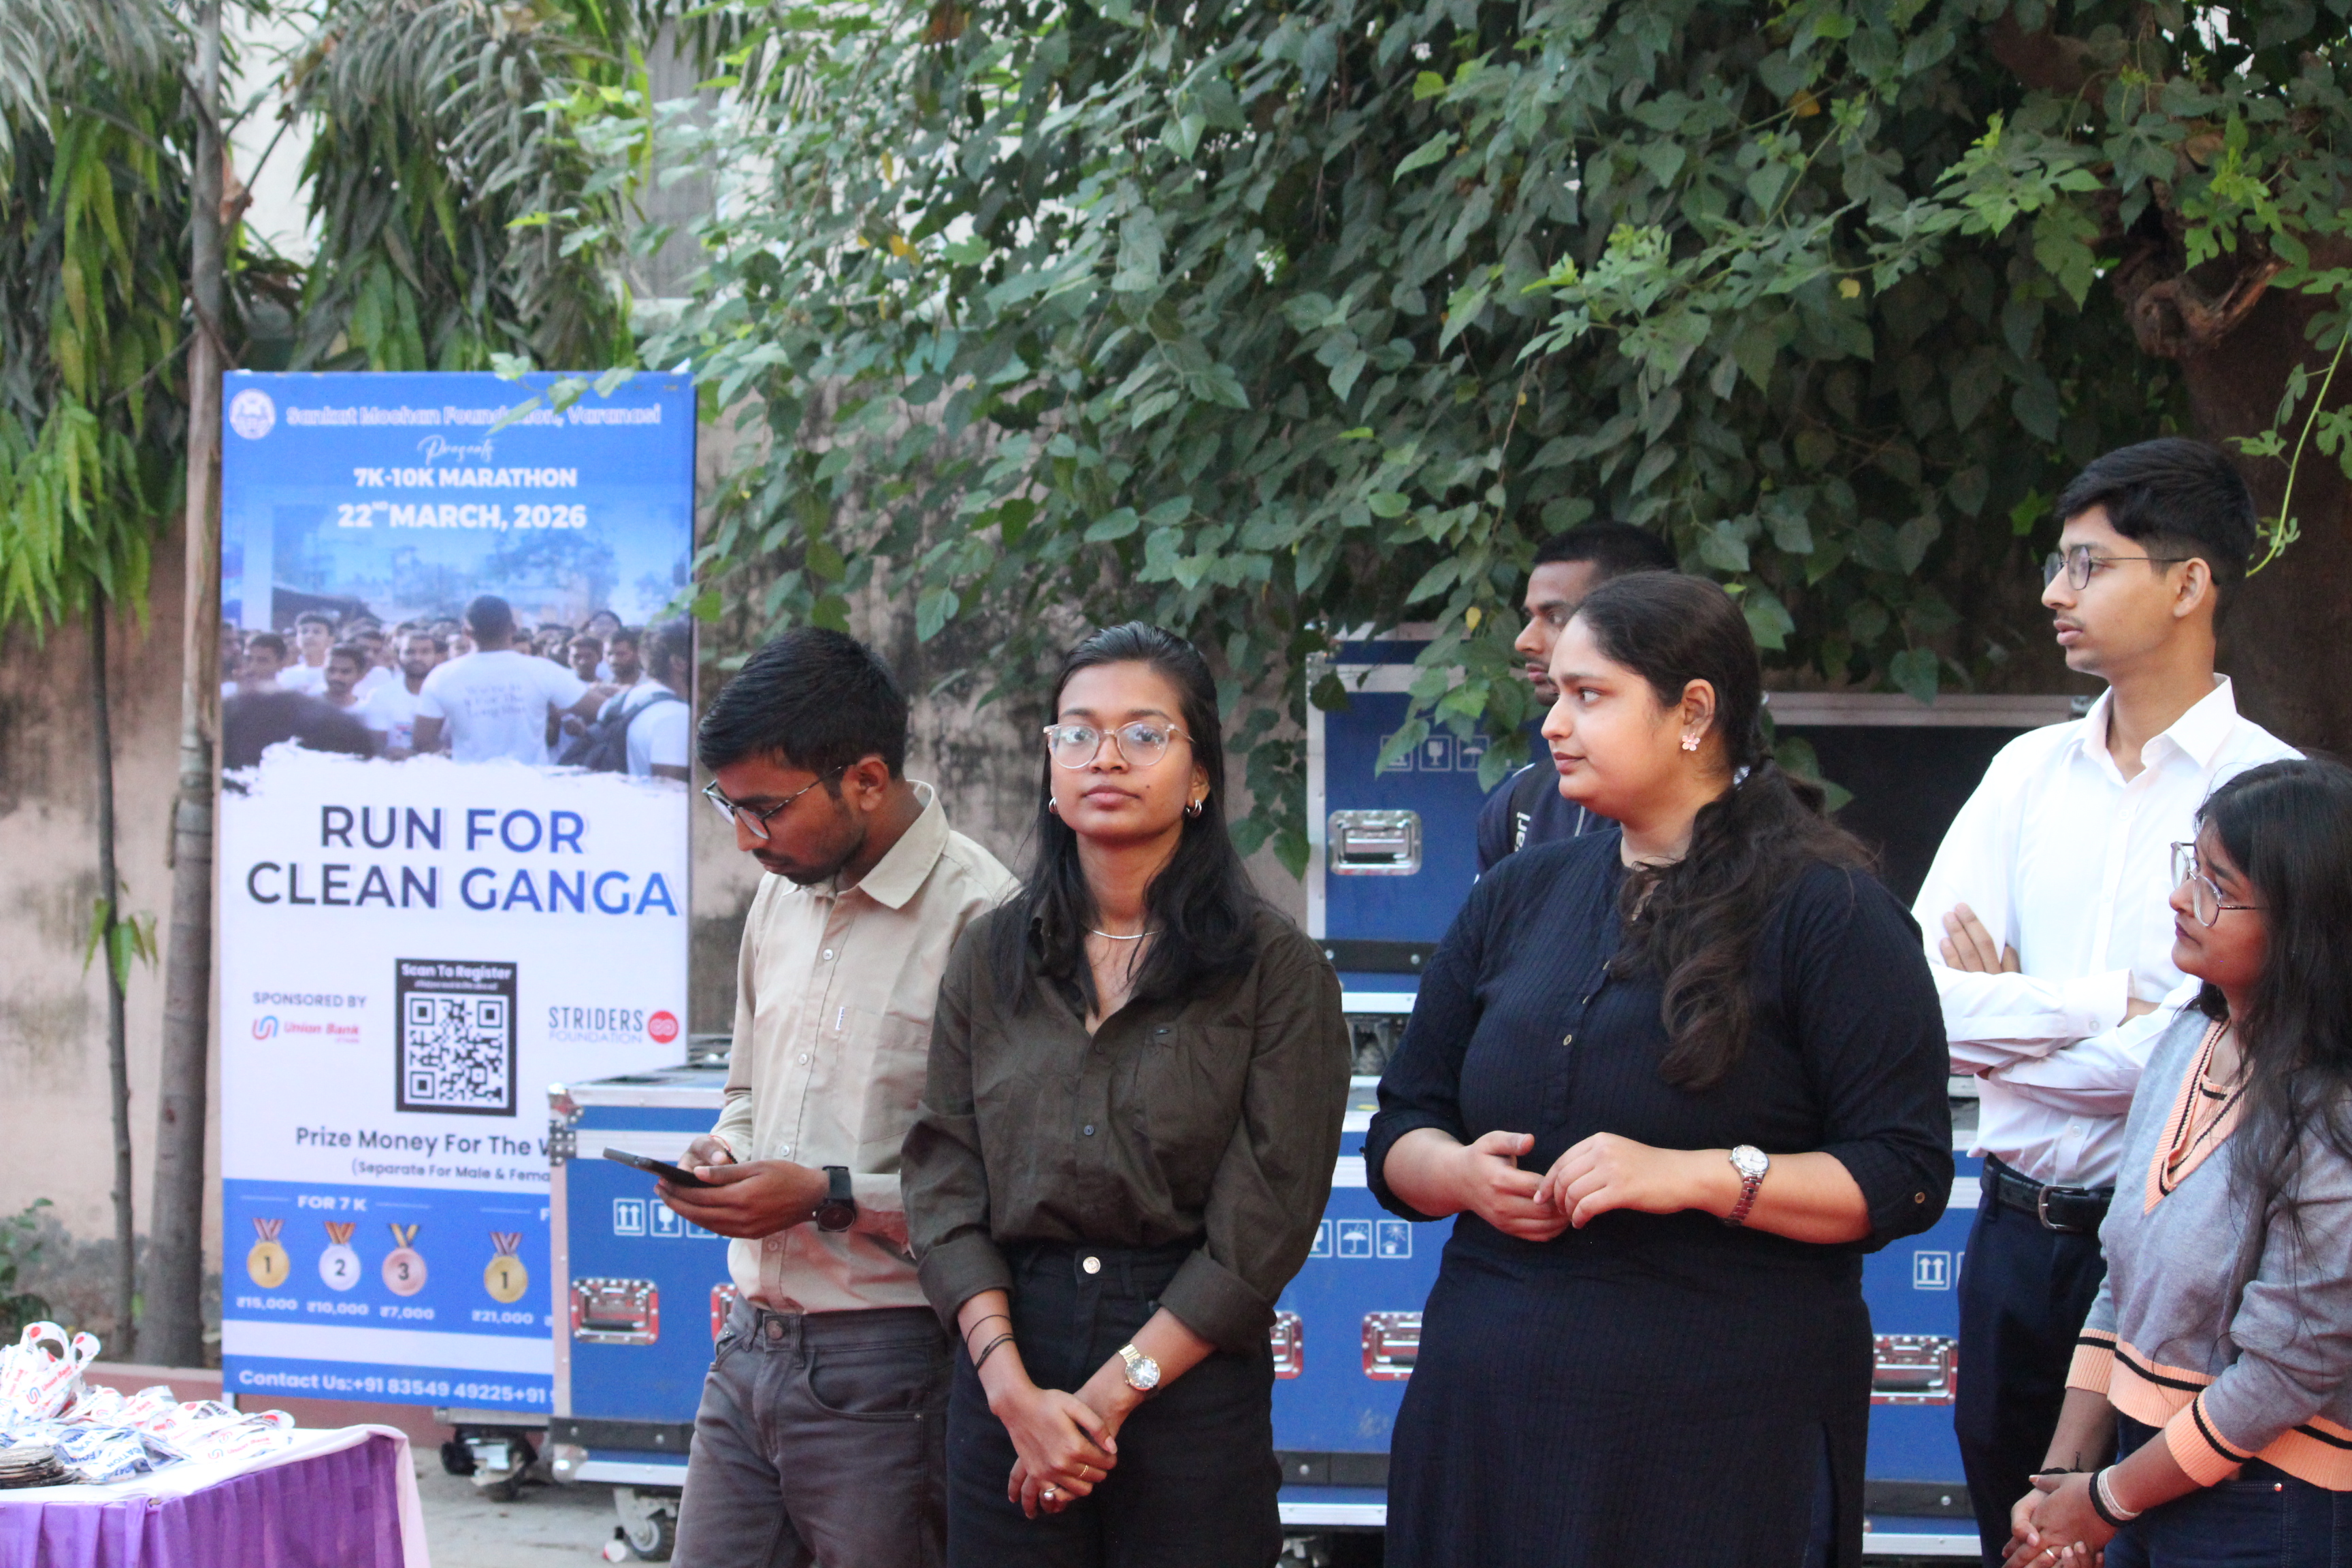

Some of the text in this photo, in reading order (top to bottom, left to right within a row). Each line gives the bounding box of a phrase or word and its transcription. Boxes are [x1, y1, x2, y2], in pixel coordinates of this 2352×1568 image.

[353, 468, 577, 488] 7K-10K MARATHON
[389, 504, 509, 532] MARCH,
[513, 504, 588, 529] 2026
[321, 805, 585, 854] RUN FOR
[1514, 812, 1531, 851] ari
[247, 861, 679, 917] CLEAN GANGA
[402, 963, 512, 982] Scan To Register
[252, 992, 366, 1008] SPONSORED BY
[284, 1022, 359, 1034] Union Bank
[549, 1006, 643, 1032] STRIDERS
[549, 1030, 642, 1044] FOUNDATION
[296, 1126, 351, 1148] Prize
[359, 1130, 437, 1158] Money
[444, 1134, 481, 1154] For
[488, 1136, 531, 1156] The
[352, 1157, 425, 1177] (Separate
[429, 1166, 451, 1178] For
[456, 1166, 491, 1180] Male
[495, 1169, 504, 1181] &
[297, 1195, 367, 1212] FOR 7 K
[264, 1256, 271, 1274] 1
[335, 1259, 346, 1277] 2
[398, 1262, 410, 1281] 3
[501, 1271, 508, 1290] 1
[239, 1369, 318, 1389] Contact
[387, 1378, 450, 1397] 83549
